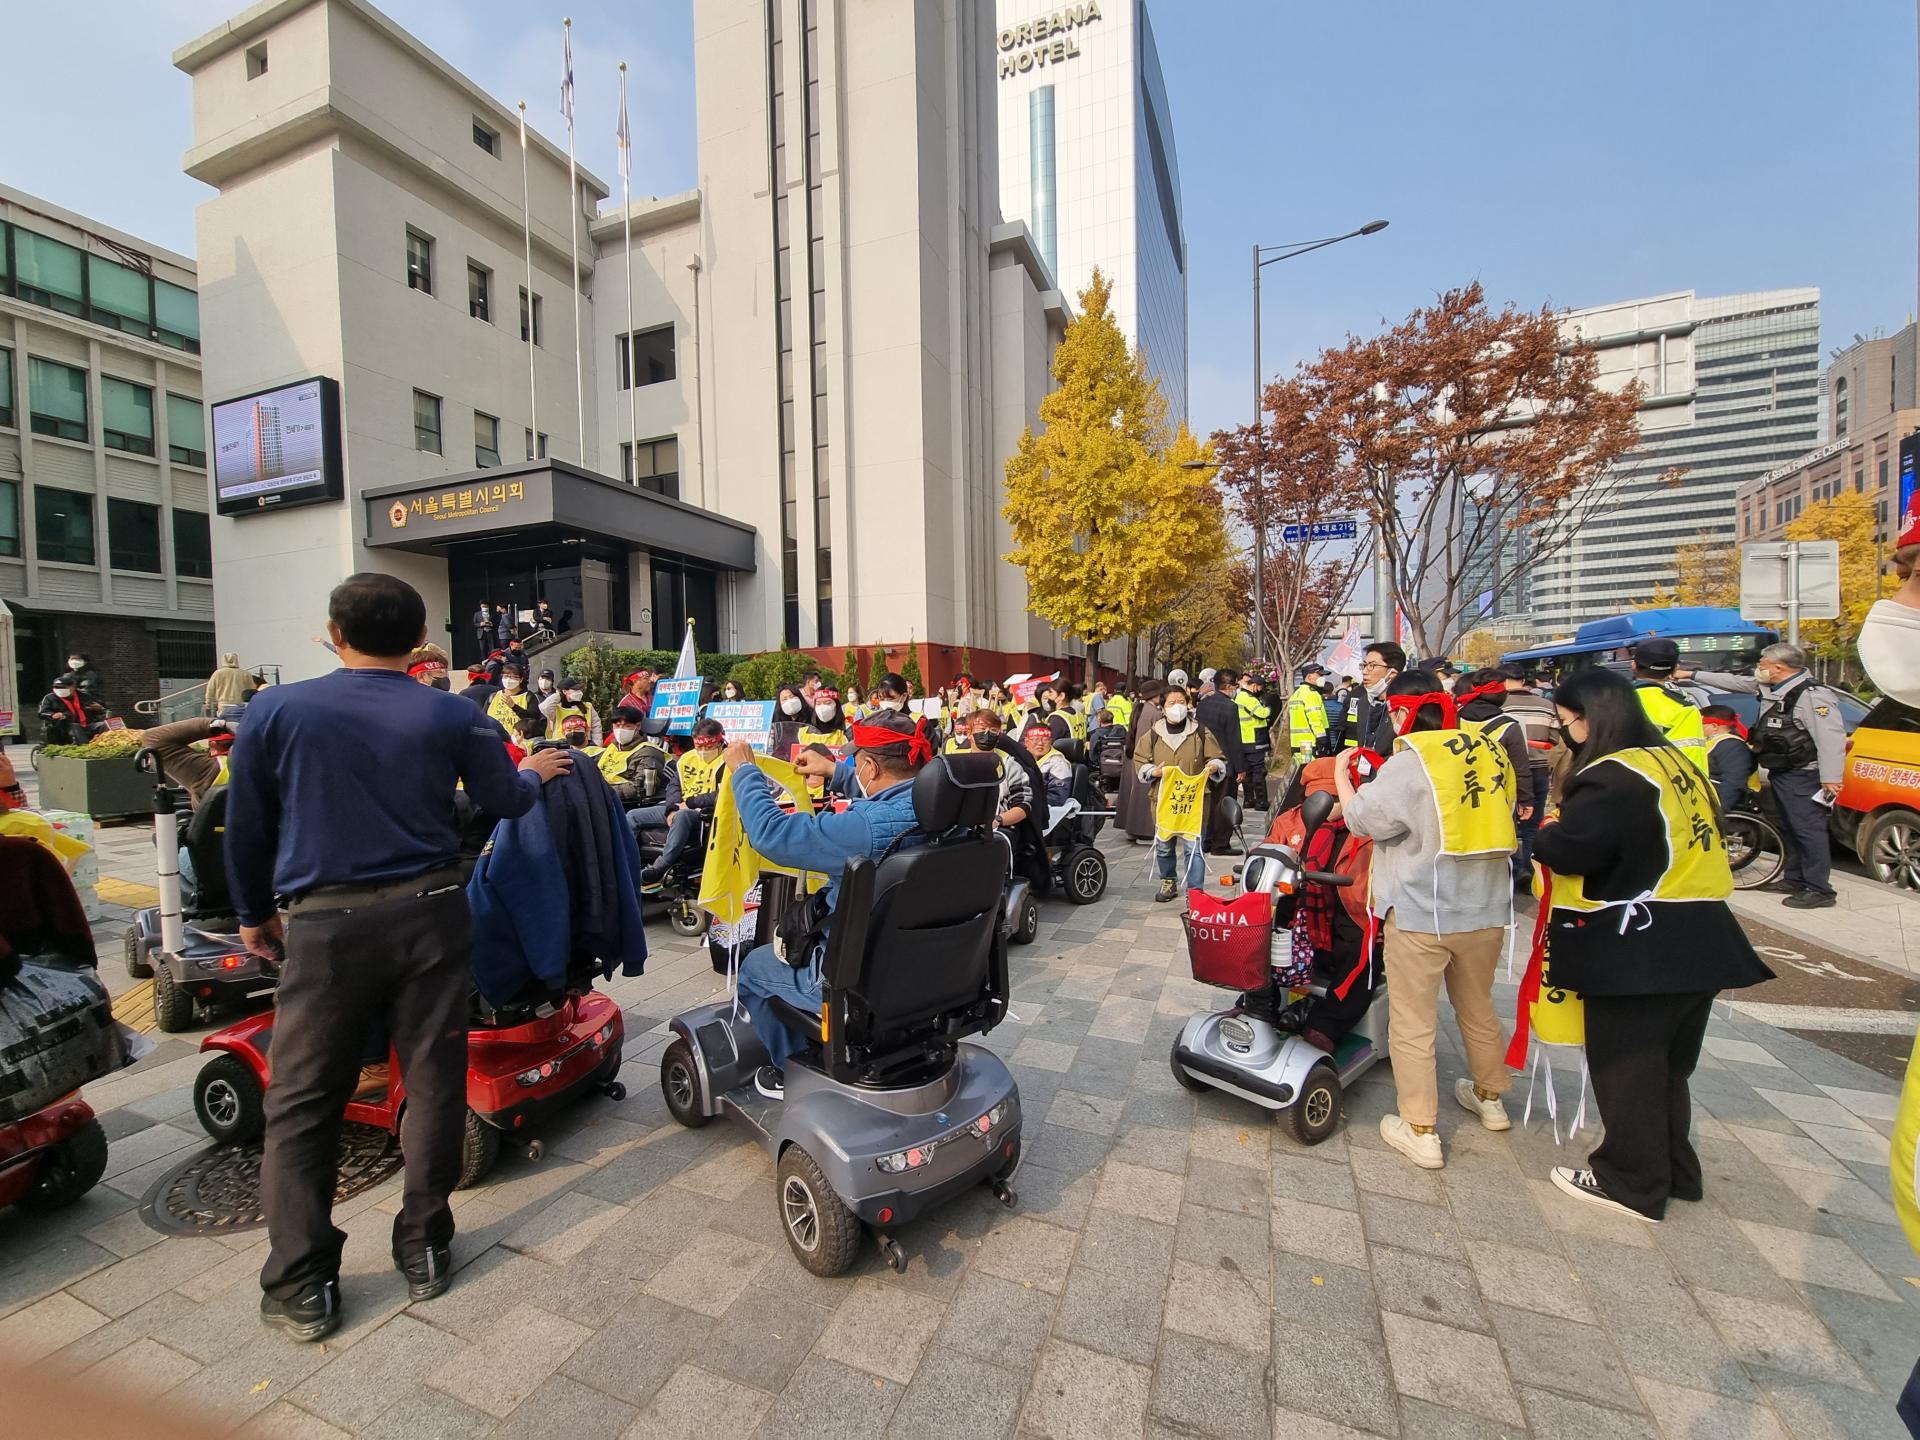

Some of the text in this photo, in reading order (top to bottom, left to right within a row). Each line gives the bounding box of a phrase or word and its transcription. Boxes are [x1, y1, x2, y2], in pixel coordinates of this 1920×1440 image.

[999, 37, 1081, 79] HOTEL
[410, 481, 524, 515] 서울특별시의회
[447, 509, 479, 519] Metropolitan
[479, 504, 499, 514] Council
[1853, 760, 1890, 782] 투쟁하여
